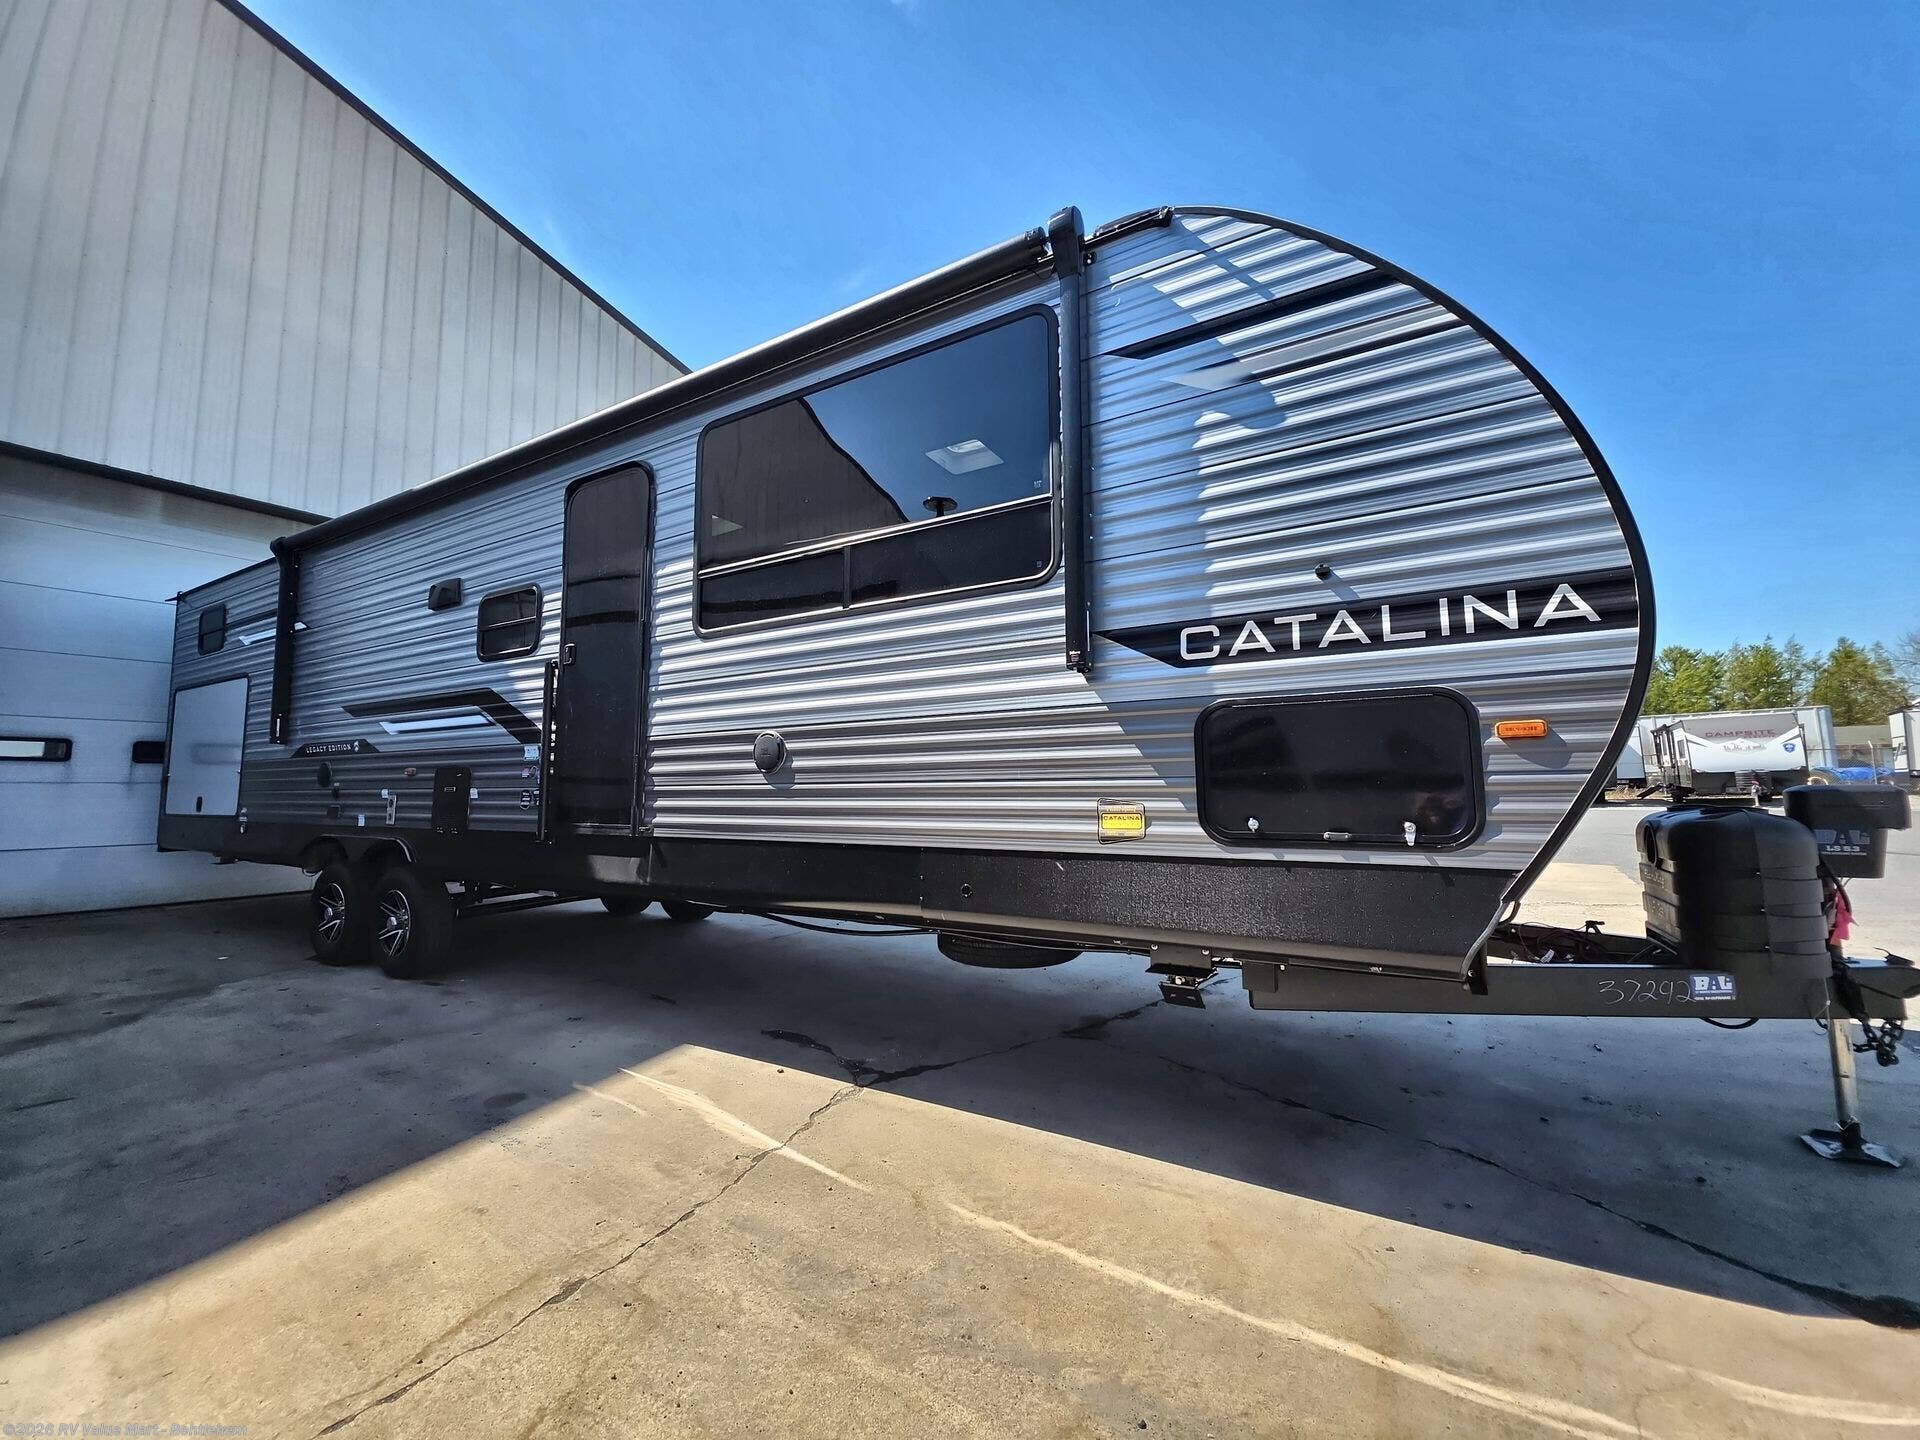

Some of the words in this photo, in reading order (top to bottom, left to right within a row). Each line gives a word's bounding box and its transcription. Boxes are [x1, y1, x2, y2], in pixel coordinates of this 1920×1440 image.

[1179, 583, 1602, 661] CATALINA
[1705, 729, 1776, 737] CAMPSITE
[306, 745, 327, 753] LEGACY
[328, 743, 352, 752] EDITION
[1693, 976, 1733, 991] BAL
[1599, 979, 1697, 1005] 37292
